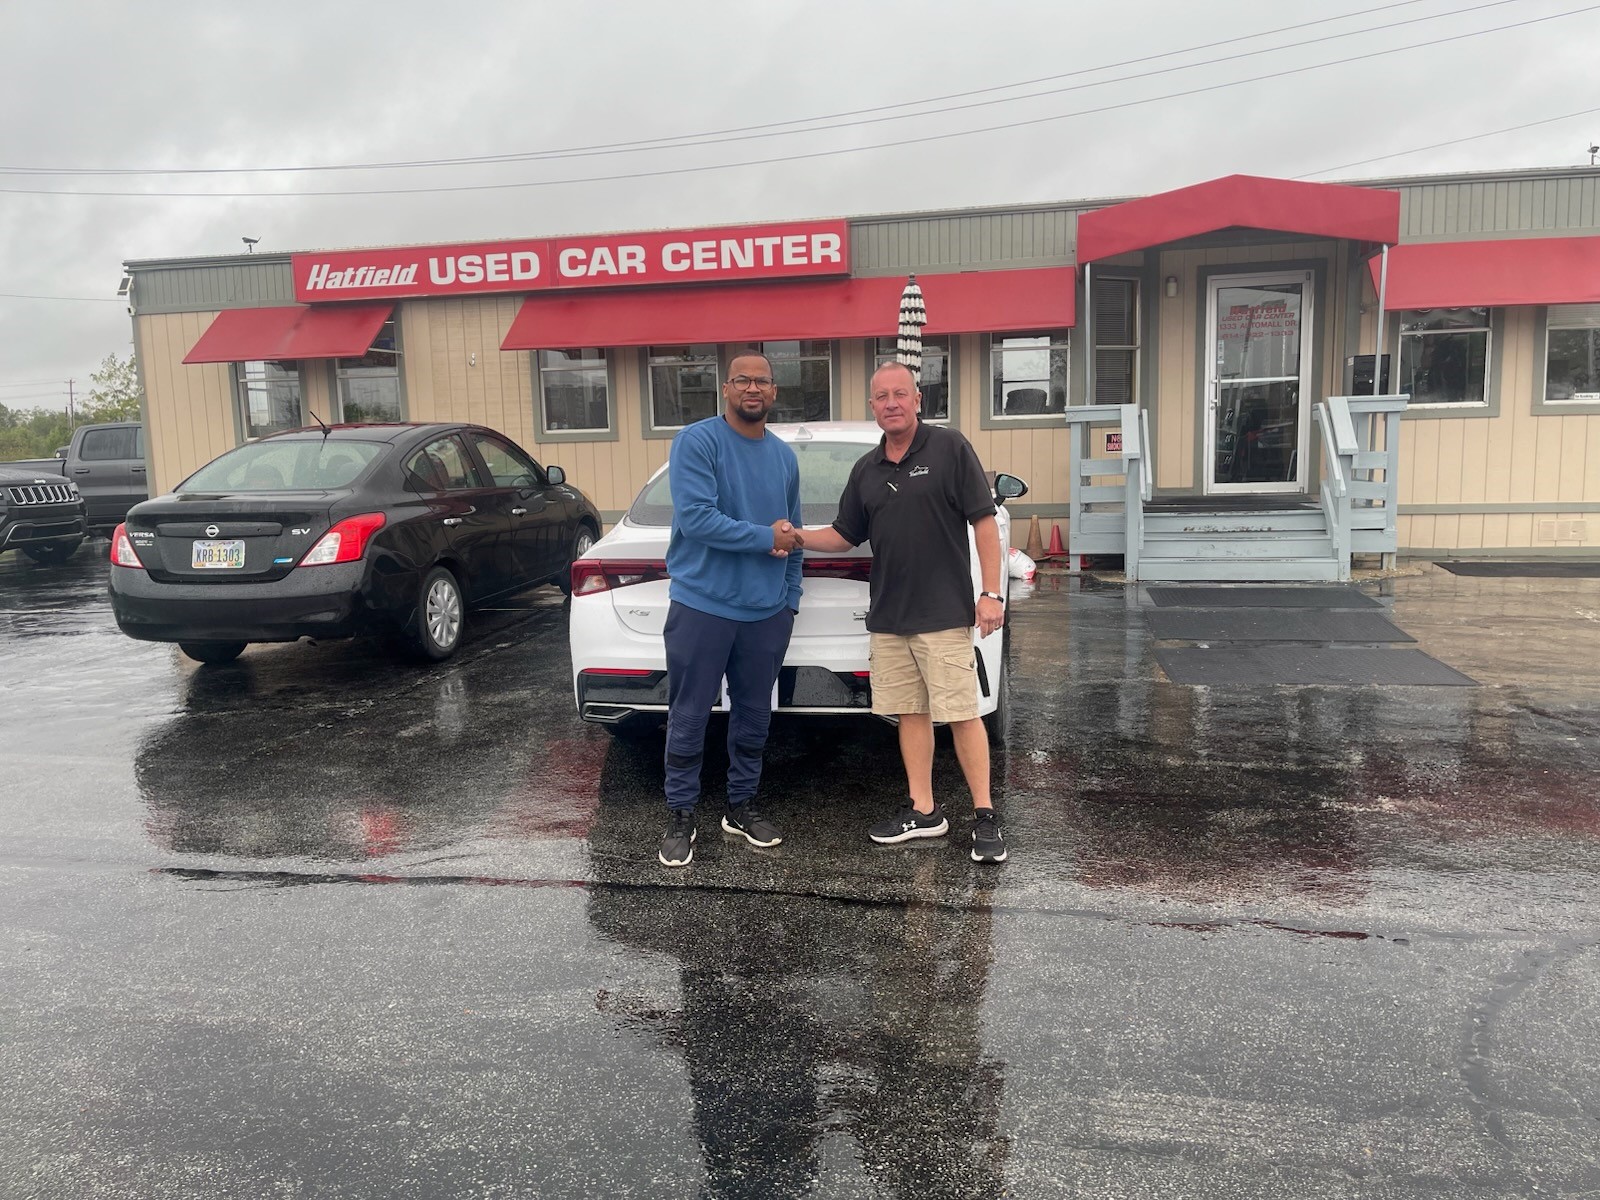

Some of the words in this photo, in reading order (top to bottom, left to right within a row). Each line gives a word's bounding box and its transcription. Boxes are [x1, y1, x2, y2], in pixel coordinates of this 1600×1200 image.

[305, 263, 418, 291] Hatfield
[429, 251, 541, 285] USED
[559, 245, 647, 278] CAR
[661, 233, 841, 272] CENTER
[1264, 312, 1295, 320] CENTER
[1240, 321, 1282, 329] AUTOMALL
[291, 528, 311, 536] SV
[196, 549, 214, 563] KRB
[217, 548, 240, 563] 1303
